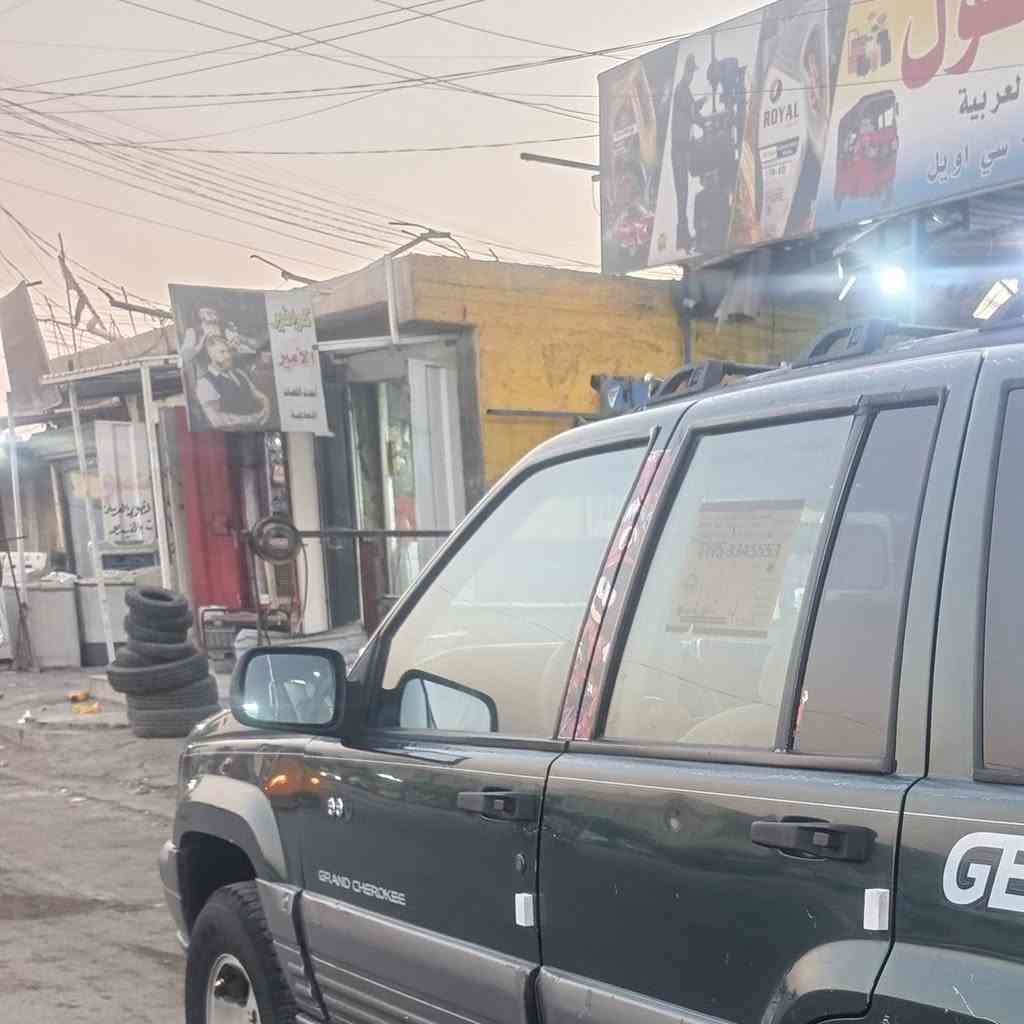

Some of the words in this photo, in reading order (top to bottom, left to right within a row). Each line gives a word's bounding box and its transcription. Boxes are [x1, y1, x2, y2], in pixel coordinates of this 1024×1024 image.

[763, 103, 799, 128] ROYAL
[318, 869, 351, 889] GRAND
[351, 879, 407, 906] CHEROKEE
